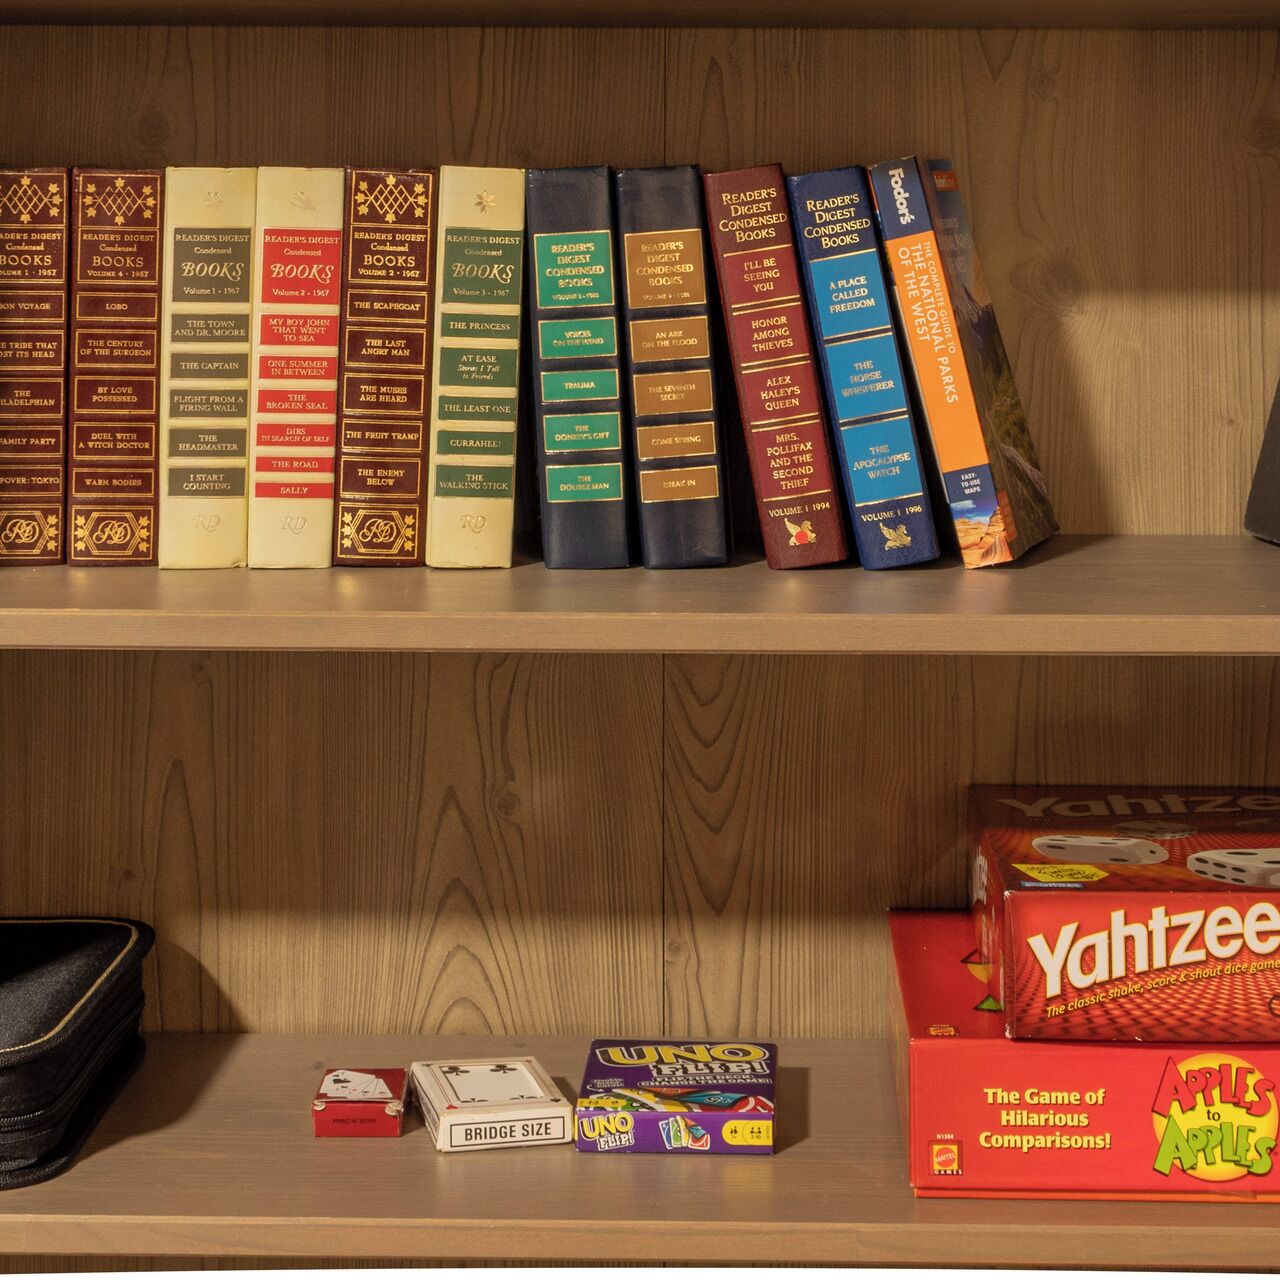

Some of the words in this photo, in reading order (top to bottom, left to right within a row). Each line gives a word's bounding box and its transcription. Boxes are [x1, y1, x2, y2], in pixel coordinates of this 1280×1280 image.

[889, 168, 915, 225] Fodor's
[730, 202, 772, 217] DIGEST
[719, 212, 787, 232] CONDENSED
[735, 228, 776, 242] BOOKS
[5, 243, 44, 251] Condensed
[181, 262, 244, 281] BOOKS
[270, 264, 334, 284] BOOKS
[830, 299, 875, 313] FREEDOM
[751, 316, 788, 328] HONOR
[910, 243, 926, 270] THE
[918, 273, 945, 353] NATIONAL
[937, 355, 958, 404] PARKS
[753, 328, 789, 341] AMONG
[752, 339, 793, 352] THIEVES
[202, 362, 239, 370] CAPTAIN
[179, 443, 238, 451] HEADMASTER
[293, 461, 318, 469] ROAD
[1046, 1004, 1065, 1018] The
[1068, 992, 1106, 1011] classic
[1108, 982, 1144, 1000] shake,
[1147, 975, 1176, 990] score
[1179, 972, 1188, 983] &
[1190, 966, 1221, 981] shout
[1224, 961, 1248, 974] dice
[595, 1043, 769, 1067] UNO
[650, 1061, 769, 1077] FLIP!
[1152, 1056, 1276, 1118] APPLES
[984, 1088, 1020, 1104] The
[1024, 1088, 1081, 1105] Game
[1085, 1088, 1106, 1105] of
[1001, 1110, 1088, 1126] Hilarious
[1207, 1109, 1220, 1121] to
[465, 1125, 516, 1142] BRIDGE
[521, 1123, 551, 1136] SIZE
[581, 1112, 634, 1140] UNO
[598, 1132, 634, 1151] FLIP!
[979, 1132, 1111, 1152] Comparisons!
[1152, 1114, 1277, 1177] APPLES
